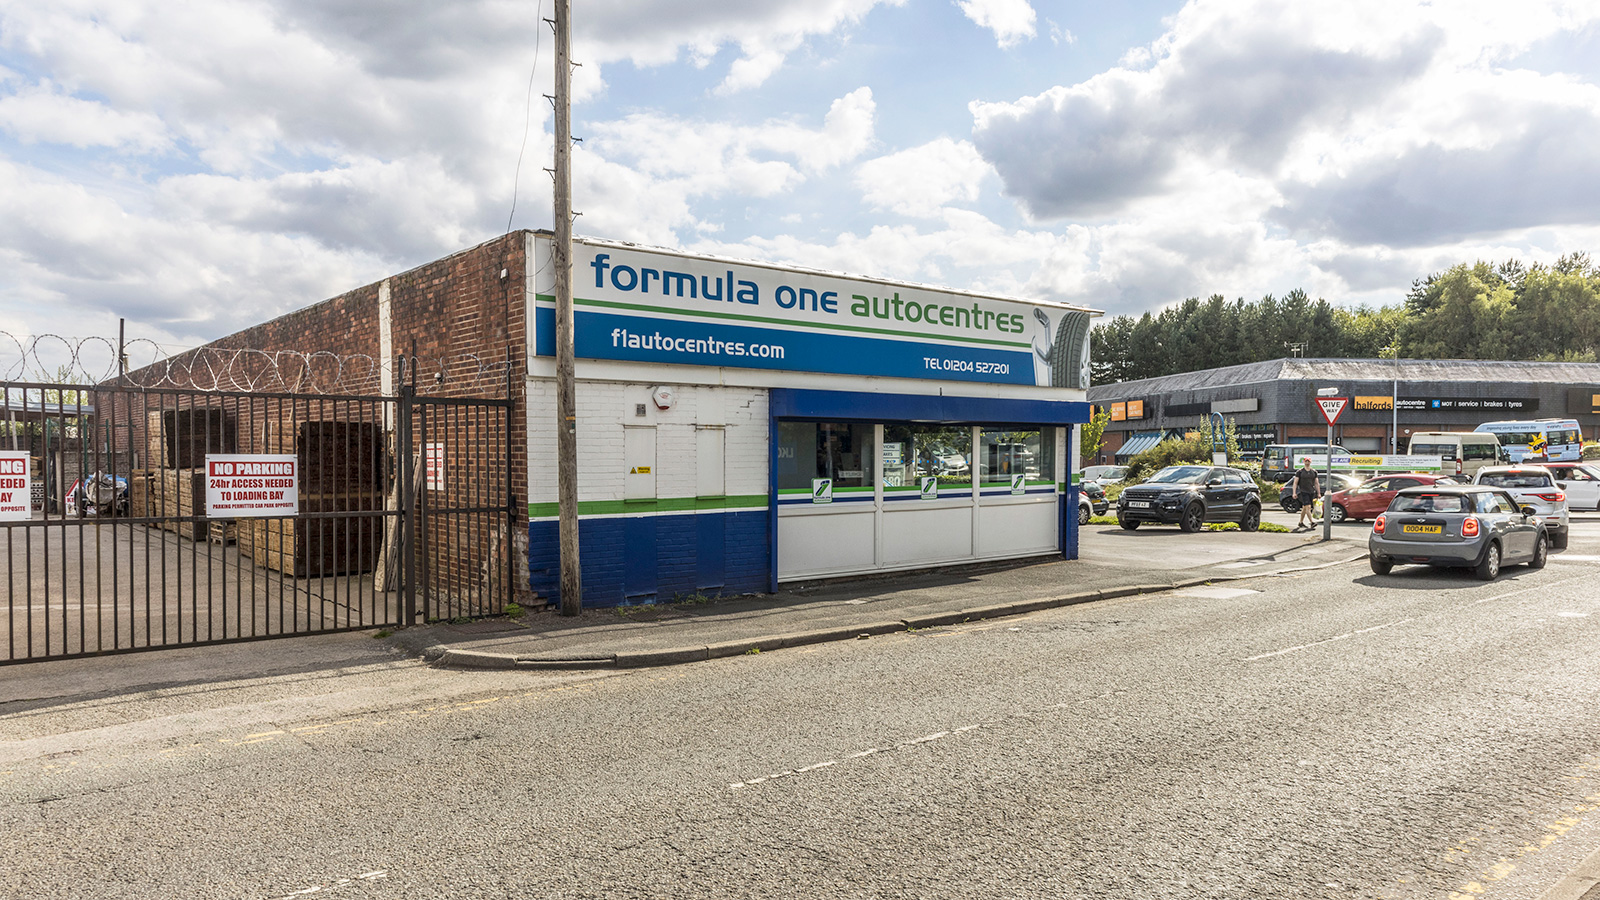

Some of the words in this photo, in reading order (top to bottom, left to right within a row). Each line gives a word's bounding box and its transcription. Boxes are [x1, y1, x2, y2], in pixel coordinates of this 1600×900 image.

[590, 254, 759, 305] formula
[775, 285, 838, 314] one
[851, 293, 1025, 334] autocentres
[611, 328, 785, 359] f1autocentres.com
[923, 357, 942, 370] TEL
[943, 360, 974, 373] 01204
[976, 362, 1009, 375] 527201
[1356, 401, 1392, 410] halfords
[1508, 401, 1523, 409] tyres
[1351, 457, 1381, 465] Recruiting
[214, 463, 234, 475] NO
[236, 463, 292, 475] PARKING
[0, 478, 25, 489] EDED
[210, 479, 230, 489] 24hr
[231, 479, 263, 488] ACCESS
[265, 478, 294, 488] NEEDED
[0, 492, 13, 503] AY
[221, 491, 232, 501] TO
[233, 491, 268, 501] LOADING
[269, 491, 284, 500] BAY
